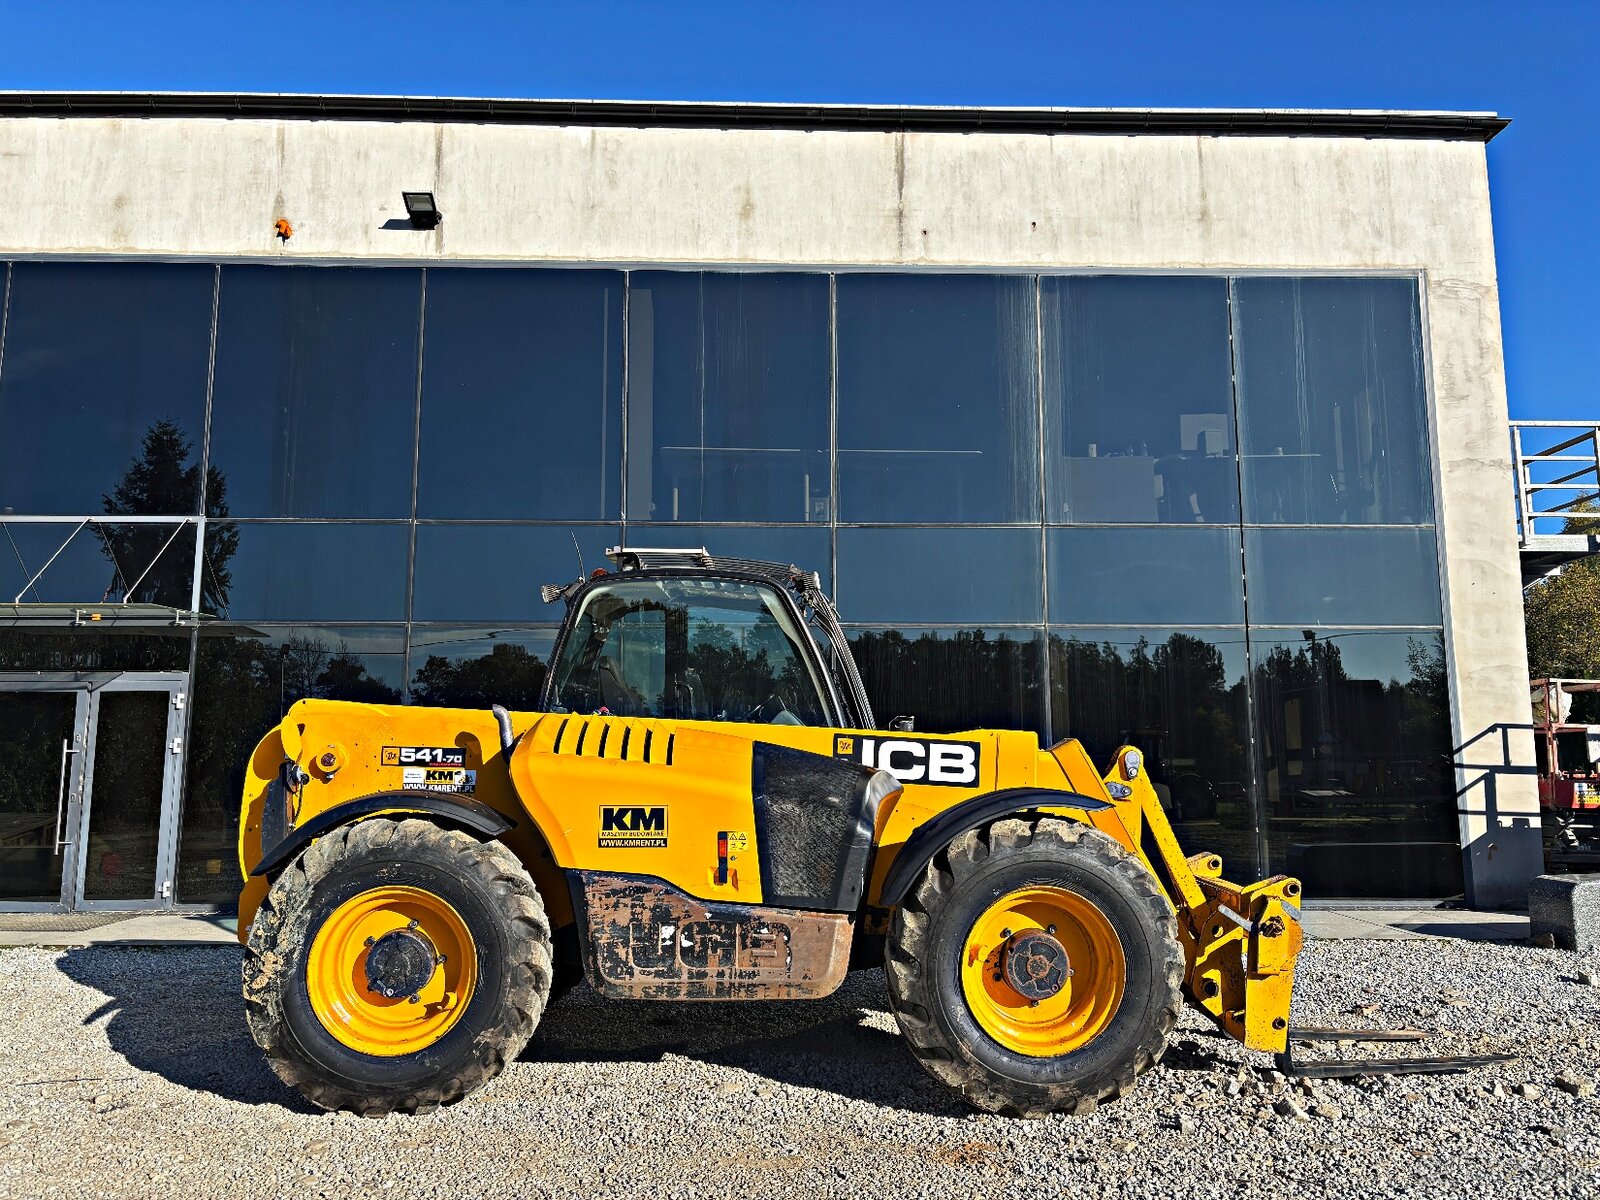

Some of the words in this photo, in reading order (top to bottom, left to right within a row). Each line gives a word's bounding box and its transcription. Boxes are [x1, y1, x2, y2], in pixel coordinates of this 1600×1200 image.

[426, 770, 454, 780] KM
[602, 808, 664, 830] KM
[600, 839, 665, 847] WWW.KMRENT.PL
